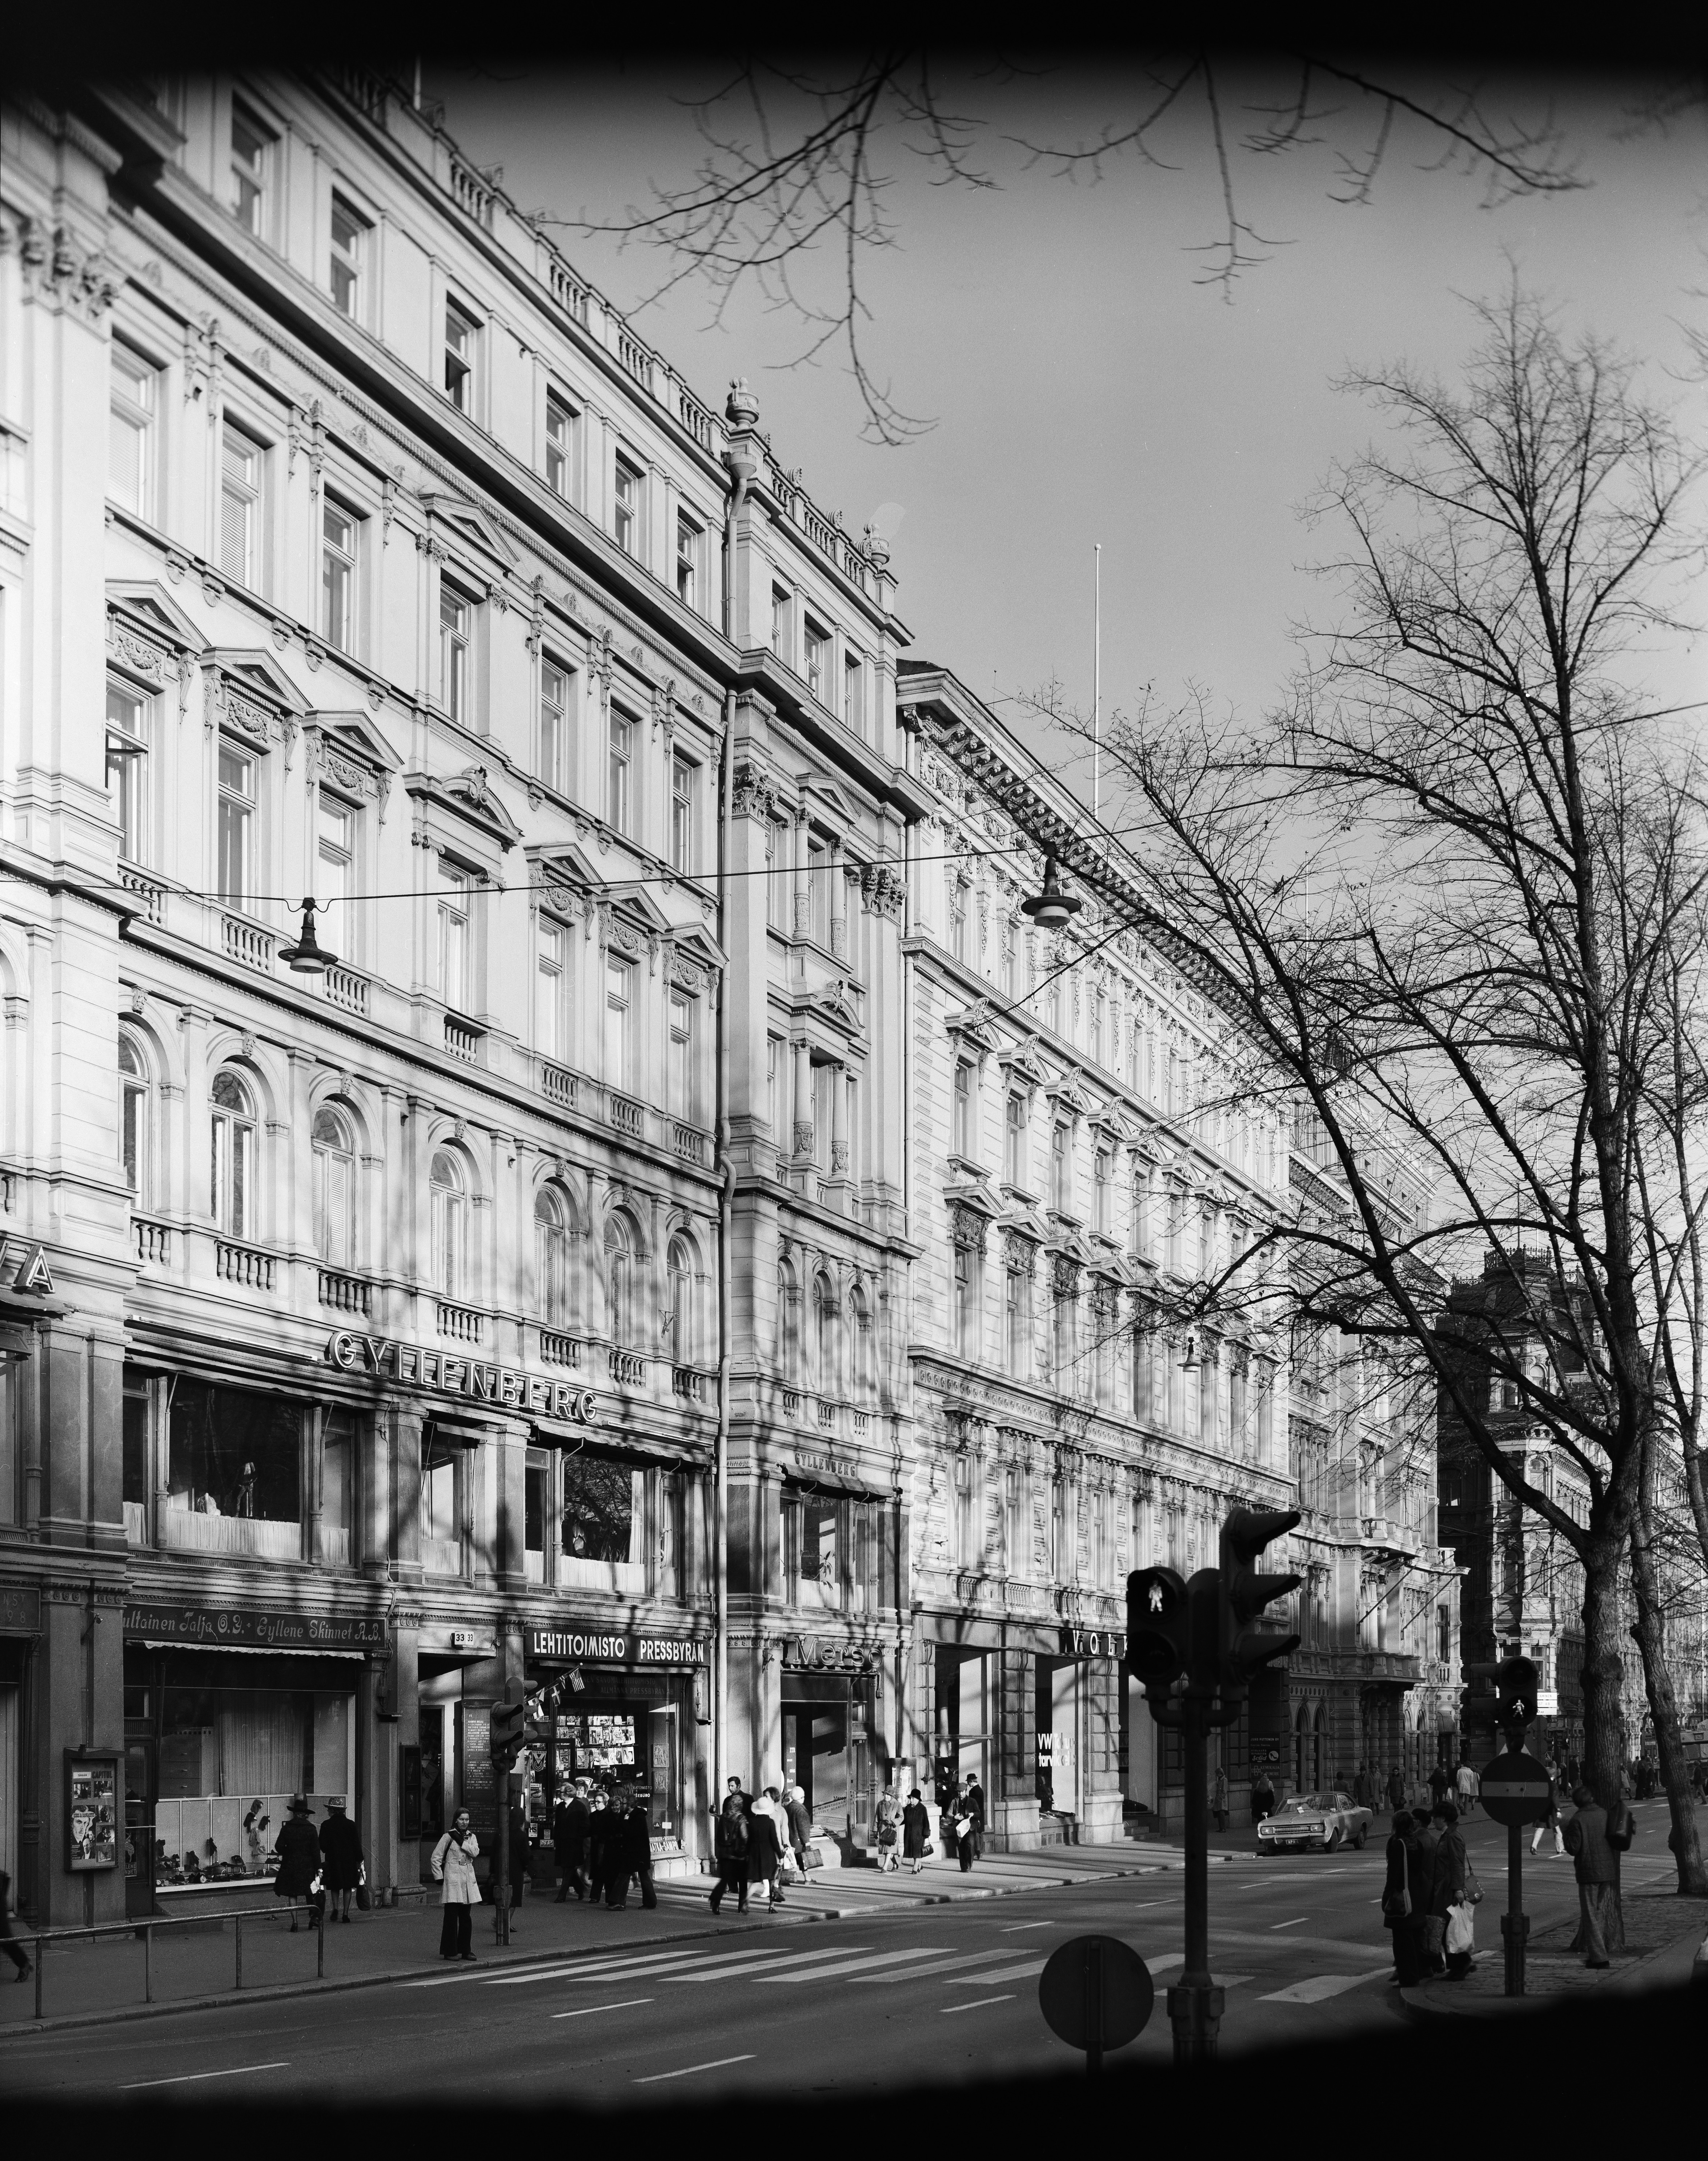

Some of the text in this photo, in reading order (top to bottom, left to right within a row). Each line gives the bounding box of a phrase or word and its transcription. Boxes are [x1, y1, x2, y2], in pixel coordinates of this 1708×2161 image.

[329, 1331, 598, 1422] GYLLENBERG
[795, 1452, 856, 1476] GYLLENBERG
[123, 1610, 176, 1631] ultainen
[179, 1611, 212, 1639] Talja
[257, 1617, 303, 1642] Gyllene
[309, 1620, 353, 1639] Skinnet
[534, 1632, 704, 1663] LEHTITOIMISTO PRESSBYRÅN
[792, 1636, 882, 1668] Merso
[601, 1685, 628, 1694] ALLMÄNNA
[630, 1687, 665, 1695] PRESSBYRÅN
[1038, 1733, 1053, 1749] VW
[92, 1771, 113, 1779] CAPITOL
